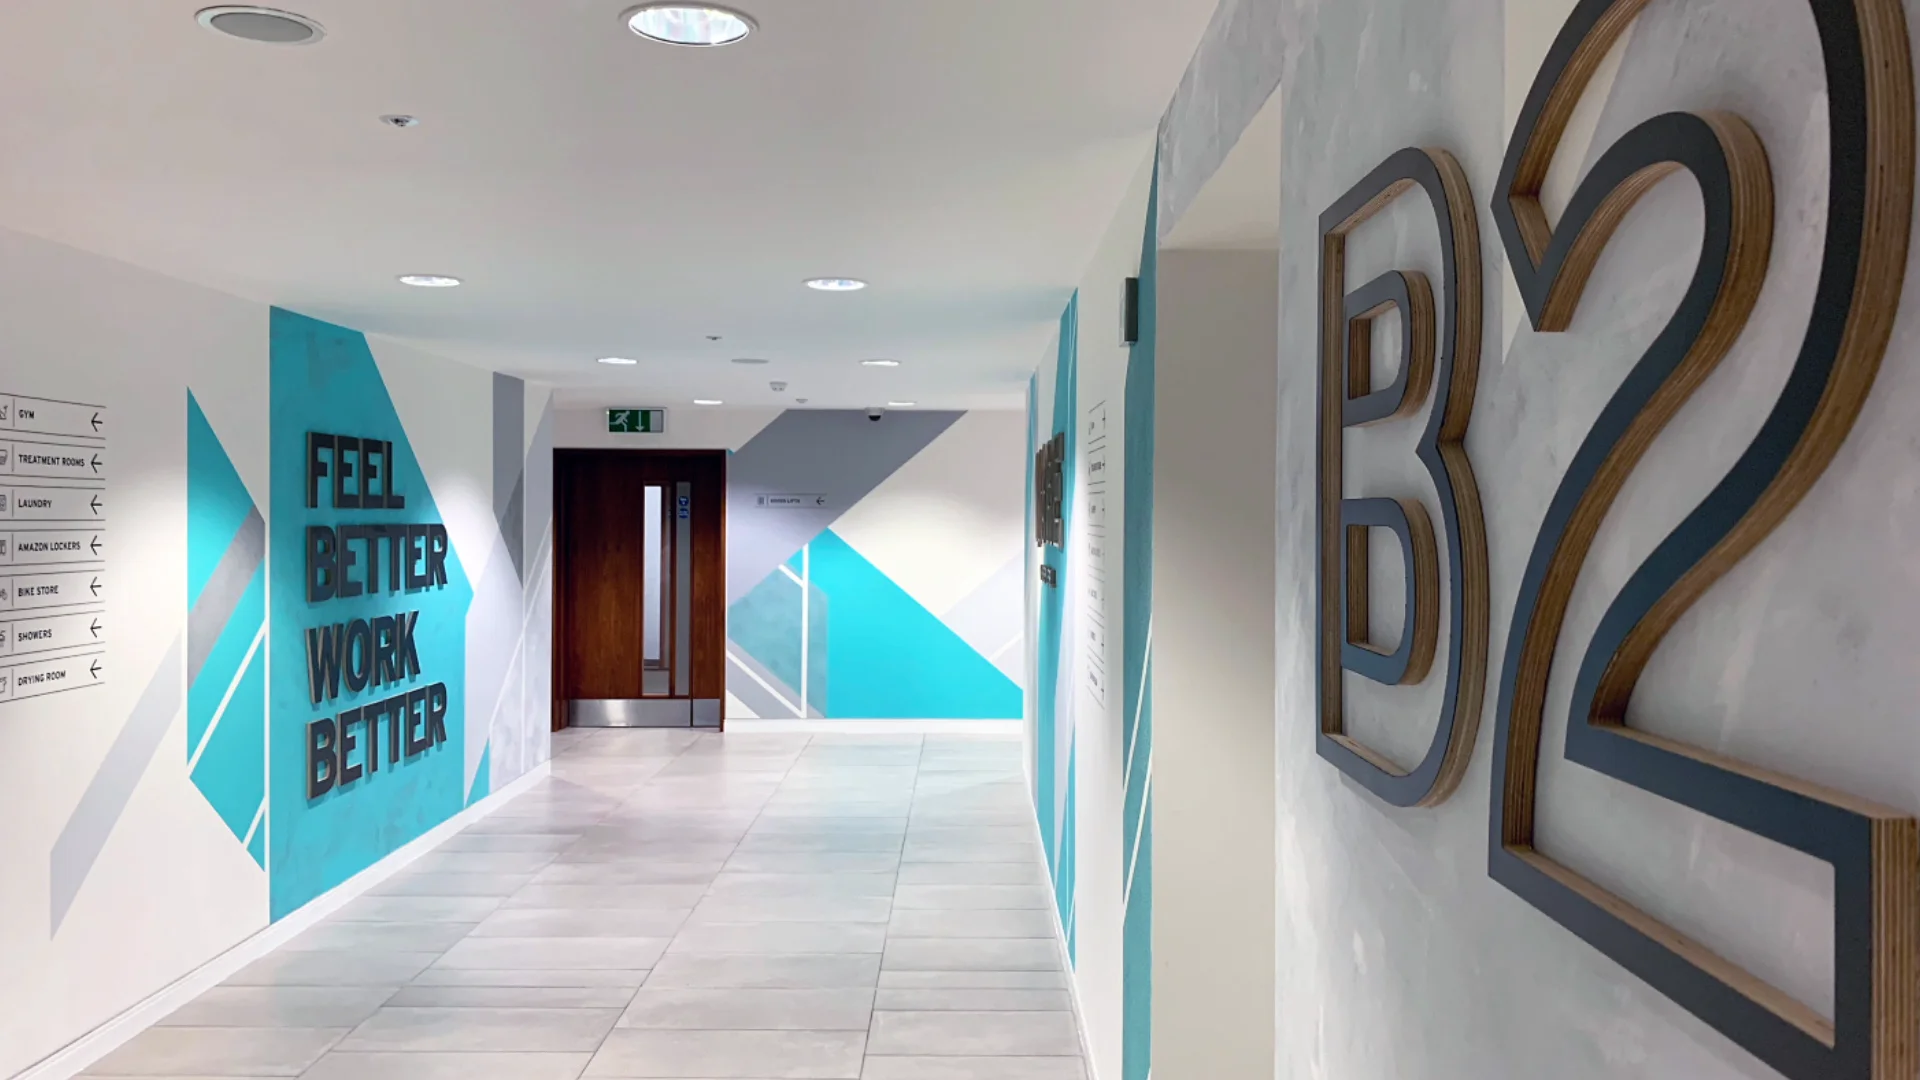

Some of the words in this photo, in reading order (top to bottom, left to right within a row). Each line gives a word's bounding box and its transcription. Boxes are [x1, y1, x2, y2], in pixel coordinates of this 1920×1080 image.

[19, 409, 35, 419] GYM
[19, 454, 60, 466] TREATMENT
[62, 457, 85, 467] ROOMS
[305, 431, 405, 509] FEEL
[18, 499, 52, 508] LAUNDRY
[18, 542, 48, 551] AMAZON
[50, 541, 81, 550] LOCKERS
[1316, 0, 1920, 1080] B2
[305, 523, 448, 602] BETTER
[18, 587, 35, 597] BIKE
[36, 585, 59, 595] STORE
[18, 629, 52, 642] SHOWERS
[305, 611, 421, 704] WORK
[18, 675, 44, 686] DRYING
[46, 670, 66, 681] ROOM
[305, 682, 448, 800] BETTER
